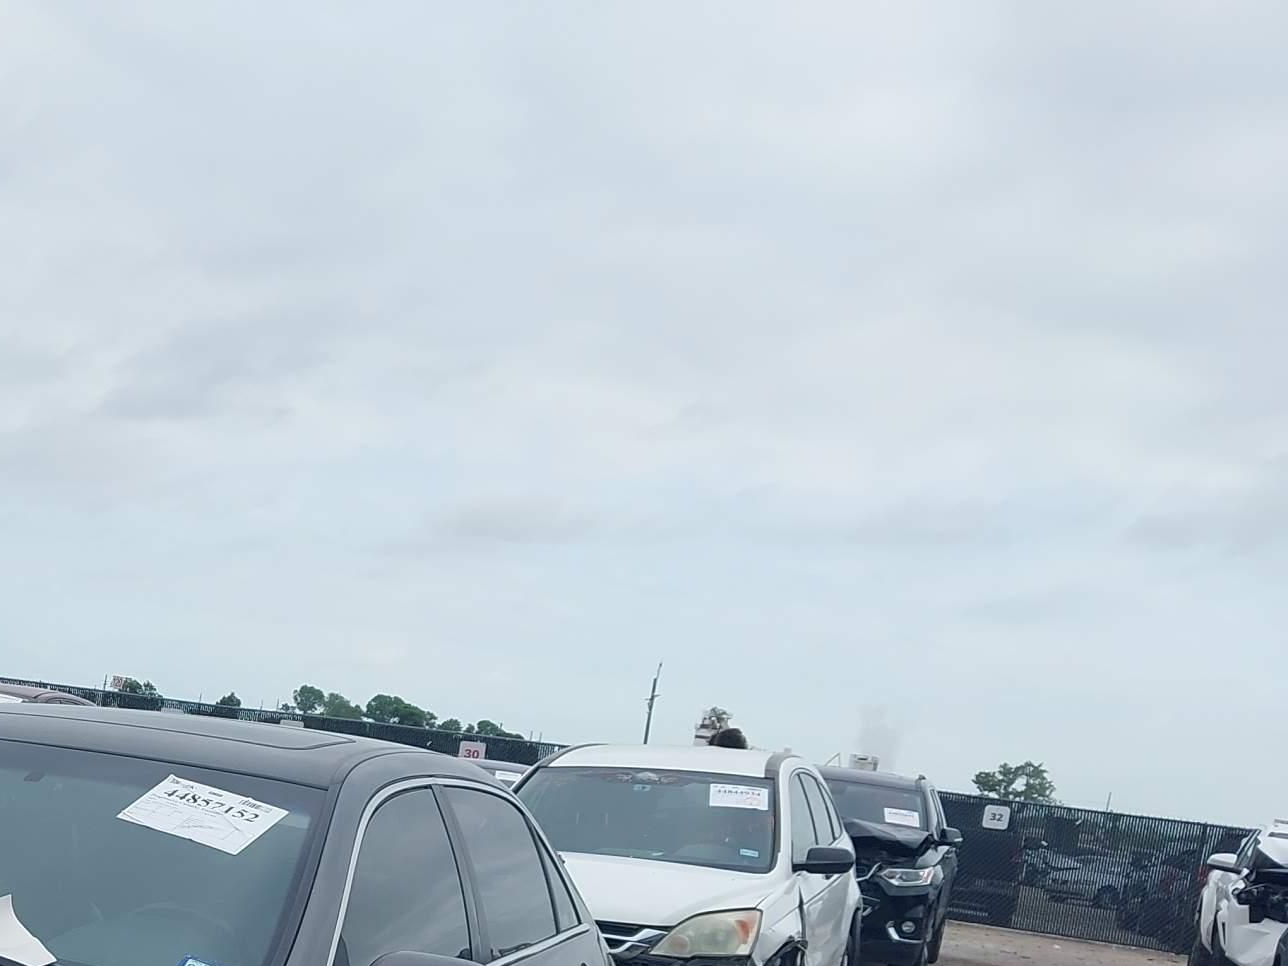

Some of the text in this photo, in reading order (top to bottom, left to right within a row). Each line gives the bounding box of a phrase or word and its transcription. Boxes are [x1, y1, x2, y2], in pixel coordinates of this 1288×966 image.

[464, 748, 479, 759] 30
[164, 789, 260, 822] 44857152
[989, 812, 1004, 822] 32
